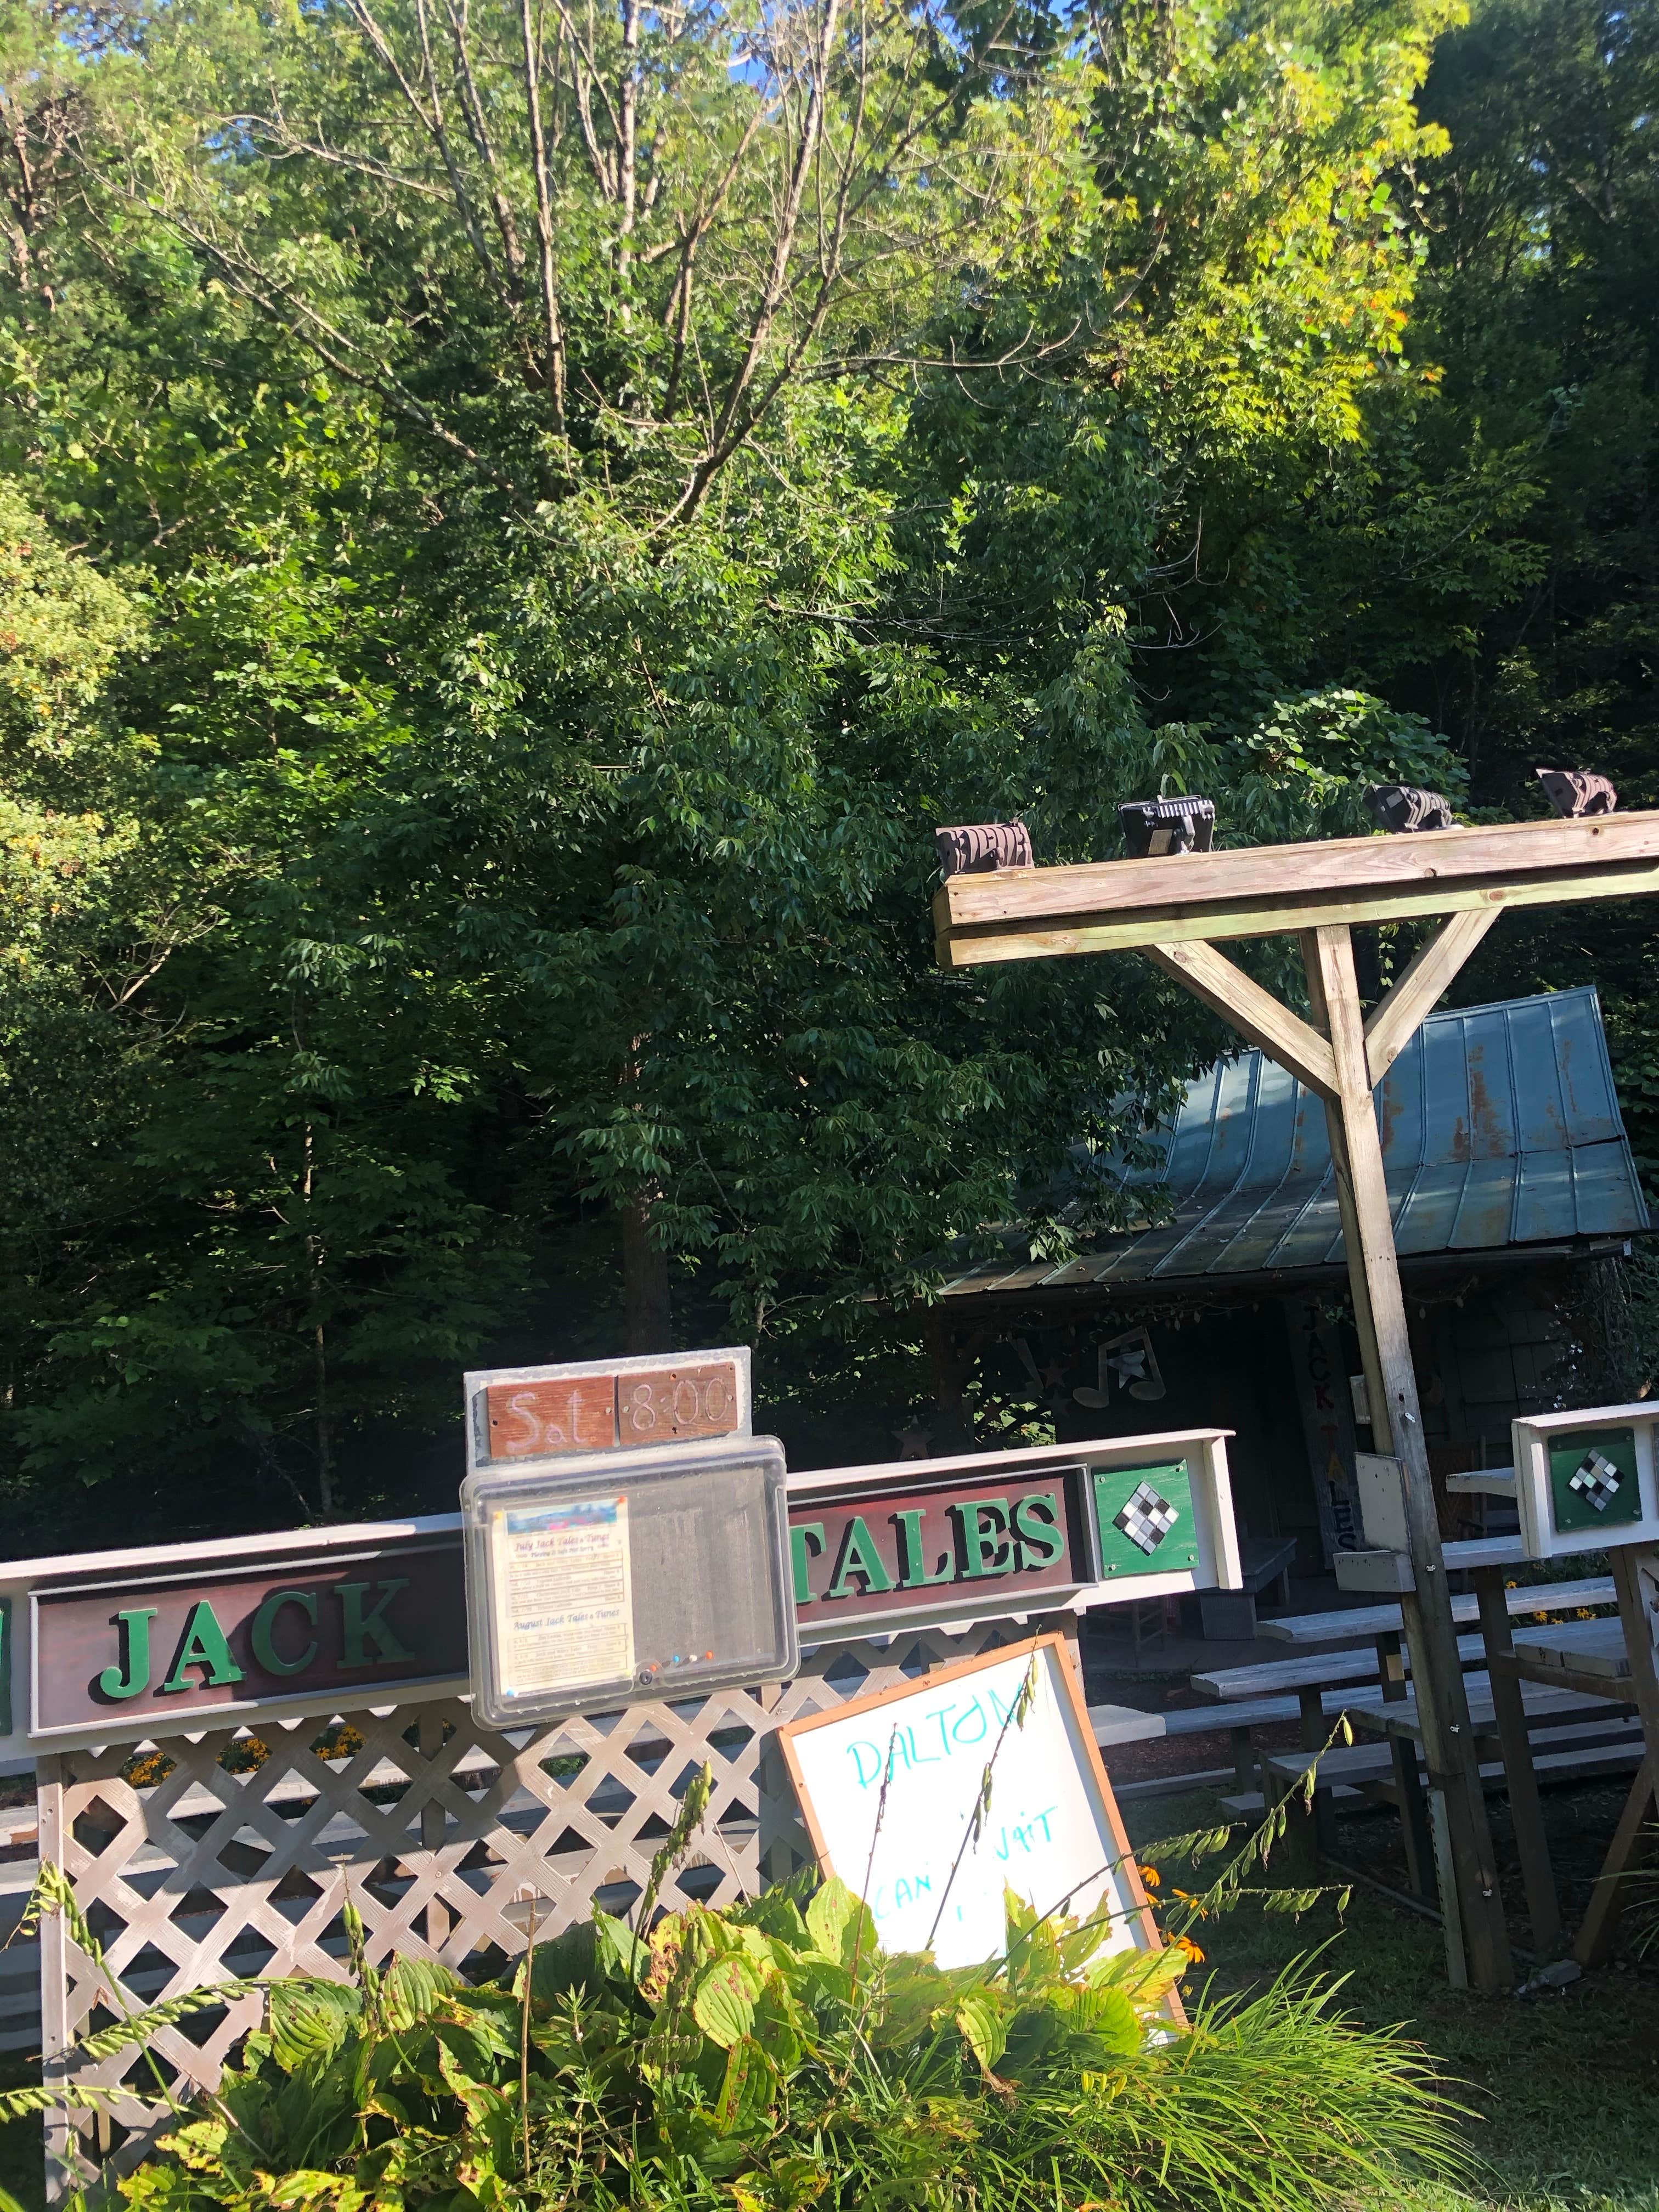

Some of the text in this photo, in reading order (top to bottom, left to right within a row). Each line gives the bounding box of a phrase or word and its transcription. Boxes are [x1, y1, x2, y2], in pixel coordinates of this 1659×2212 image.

[505, 1377, 729, 1453] Sat 8:00
[536, 1538, 555, 1549] Jack
[558, 1536, 578, 1545] Tales
[99, 1577, 416, 1699] JACK
[790, 1492, 1065, 1603] TALES
[514, 1619, 543, 1631] August
[545, 1616, 565, 1626] Jack
[567, 1612, 589, 1623] Tales
[595, 1608, 620, 1618] Tunes
[847, 1682, 1023, 1790] DALTON
